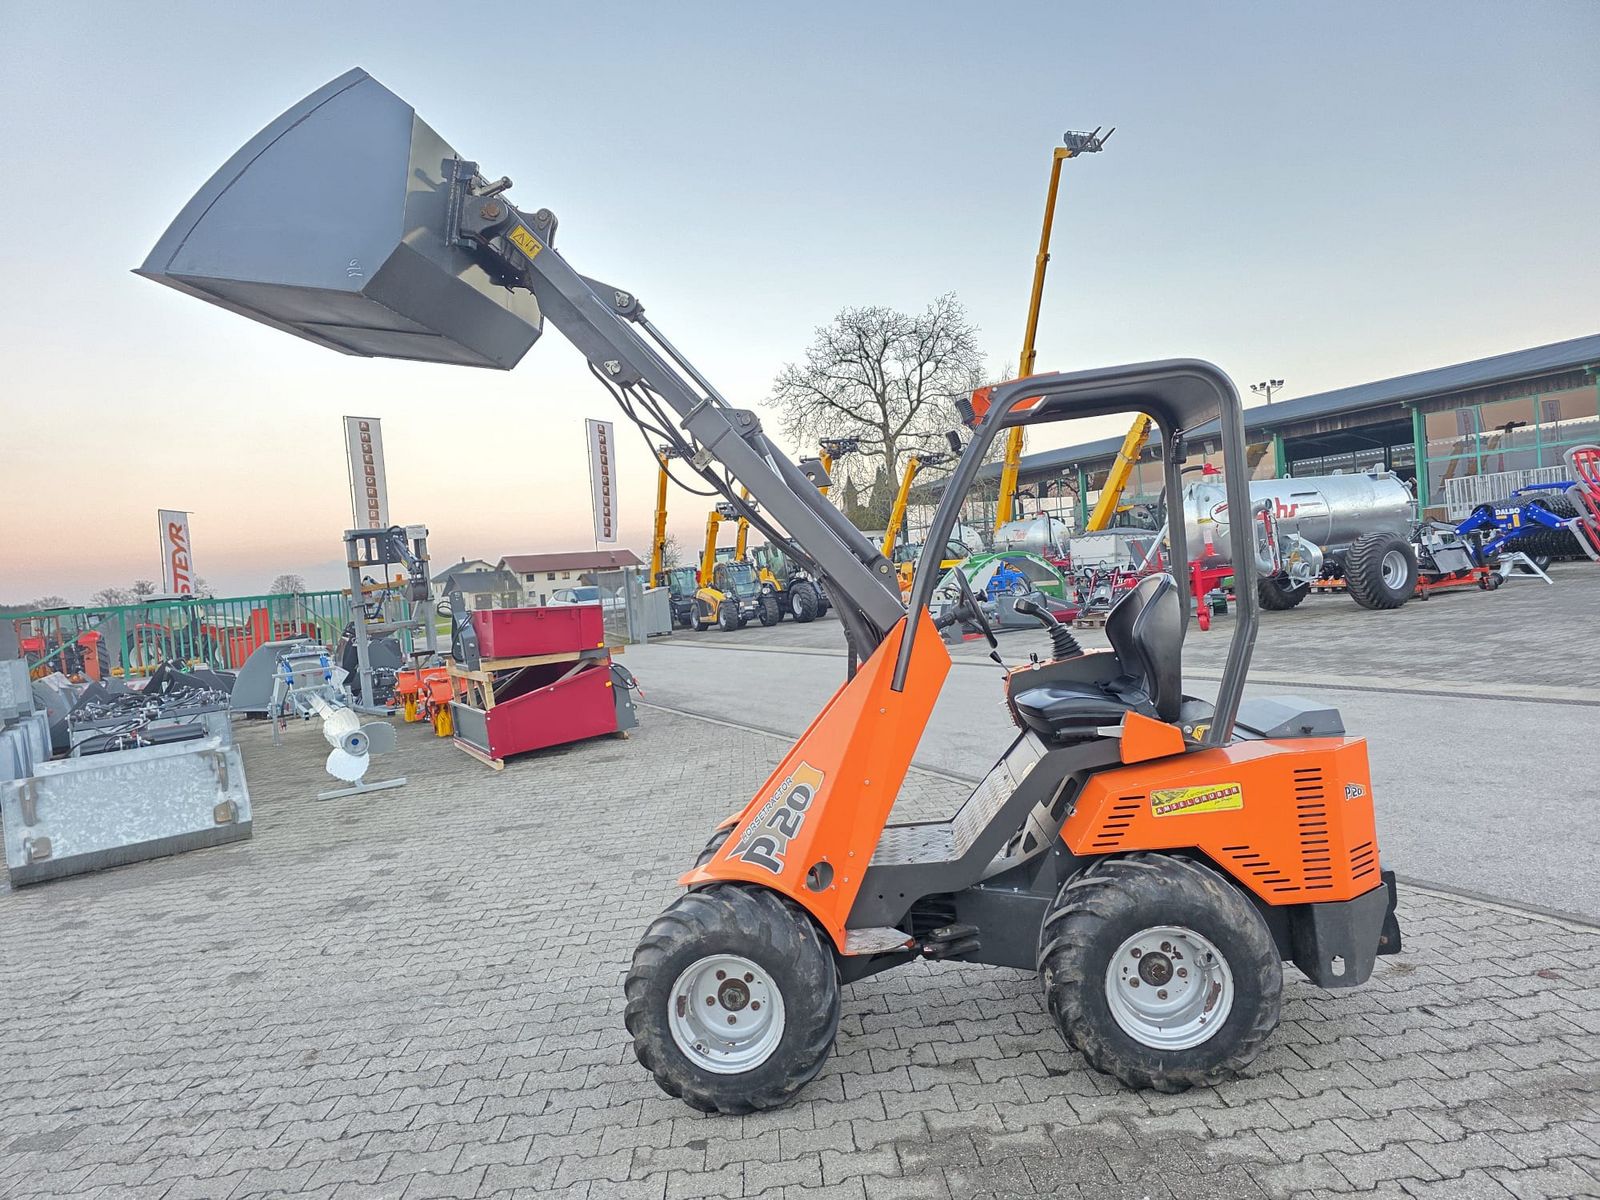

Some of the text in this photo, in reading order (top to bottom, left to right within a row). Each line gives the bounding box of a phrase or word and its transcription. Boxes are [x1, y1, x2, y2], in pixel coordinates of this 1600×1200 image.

[359, 421, 380, 529] AMSELGRUBE
[1494, 507, 1521, 516] DALBO
[1155, 786, 1240, 815] AMSELGRUBER
[1344, 785, 1363, 801] P20
[742, 776, 793, 844] HORSETRACTOR
